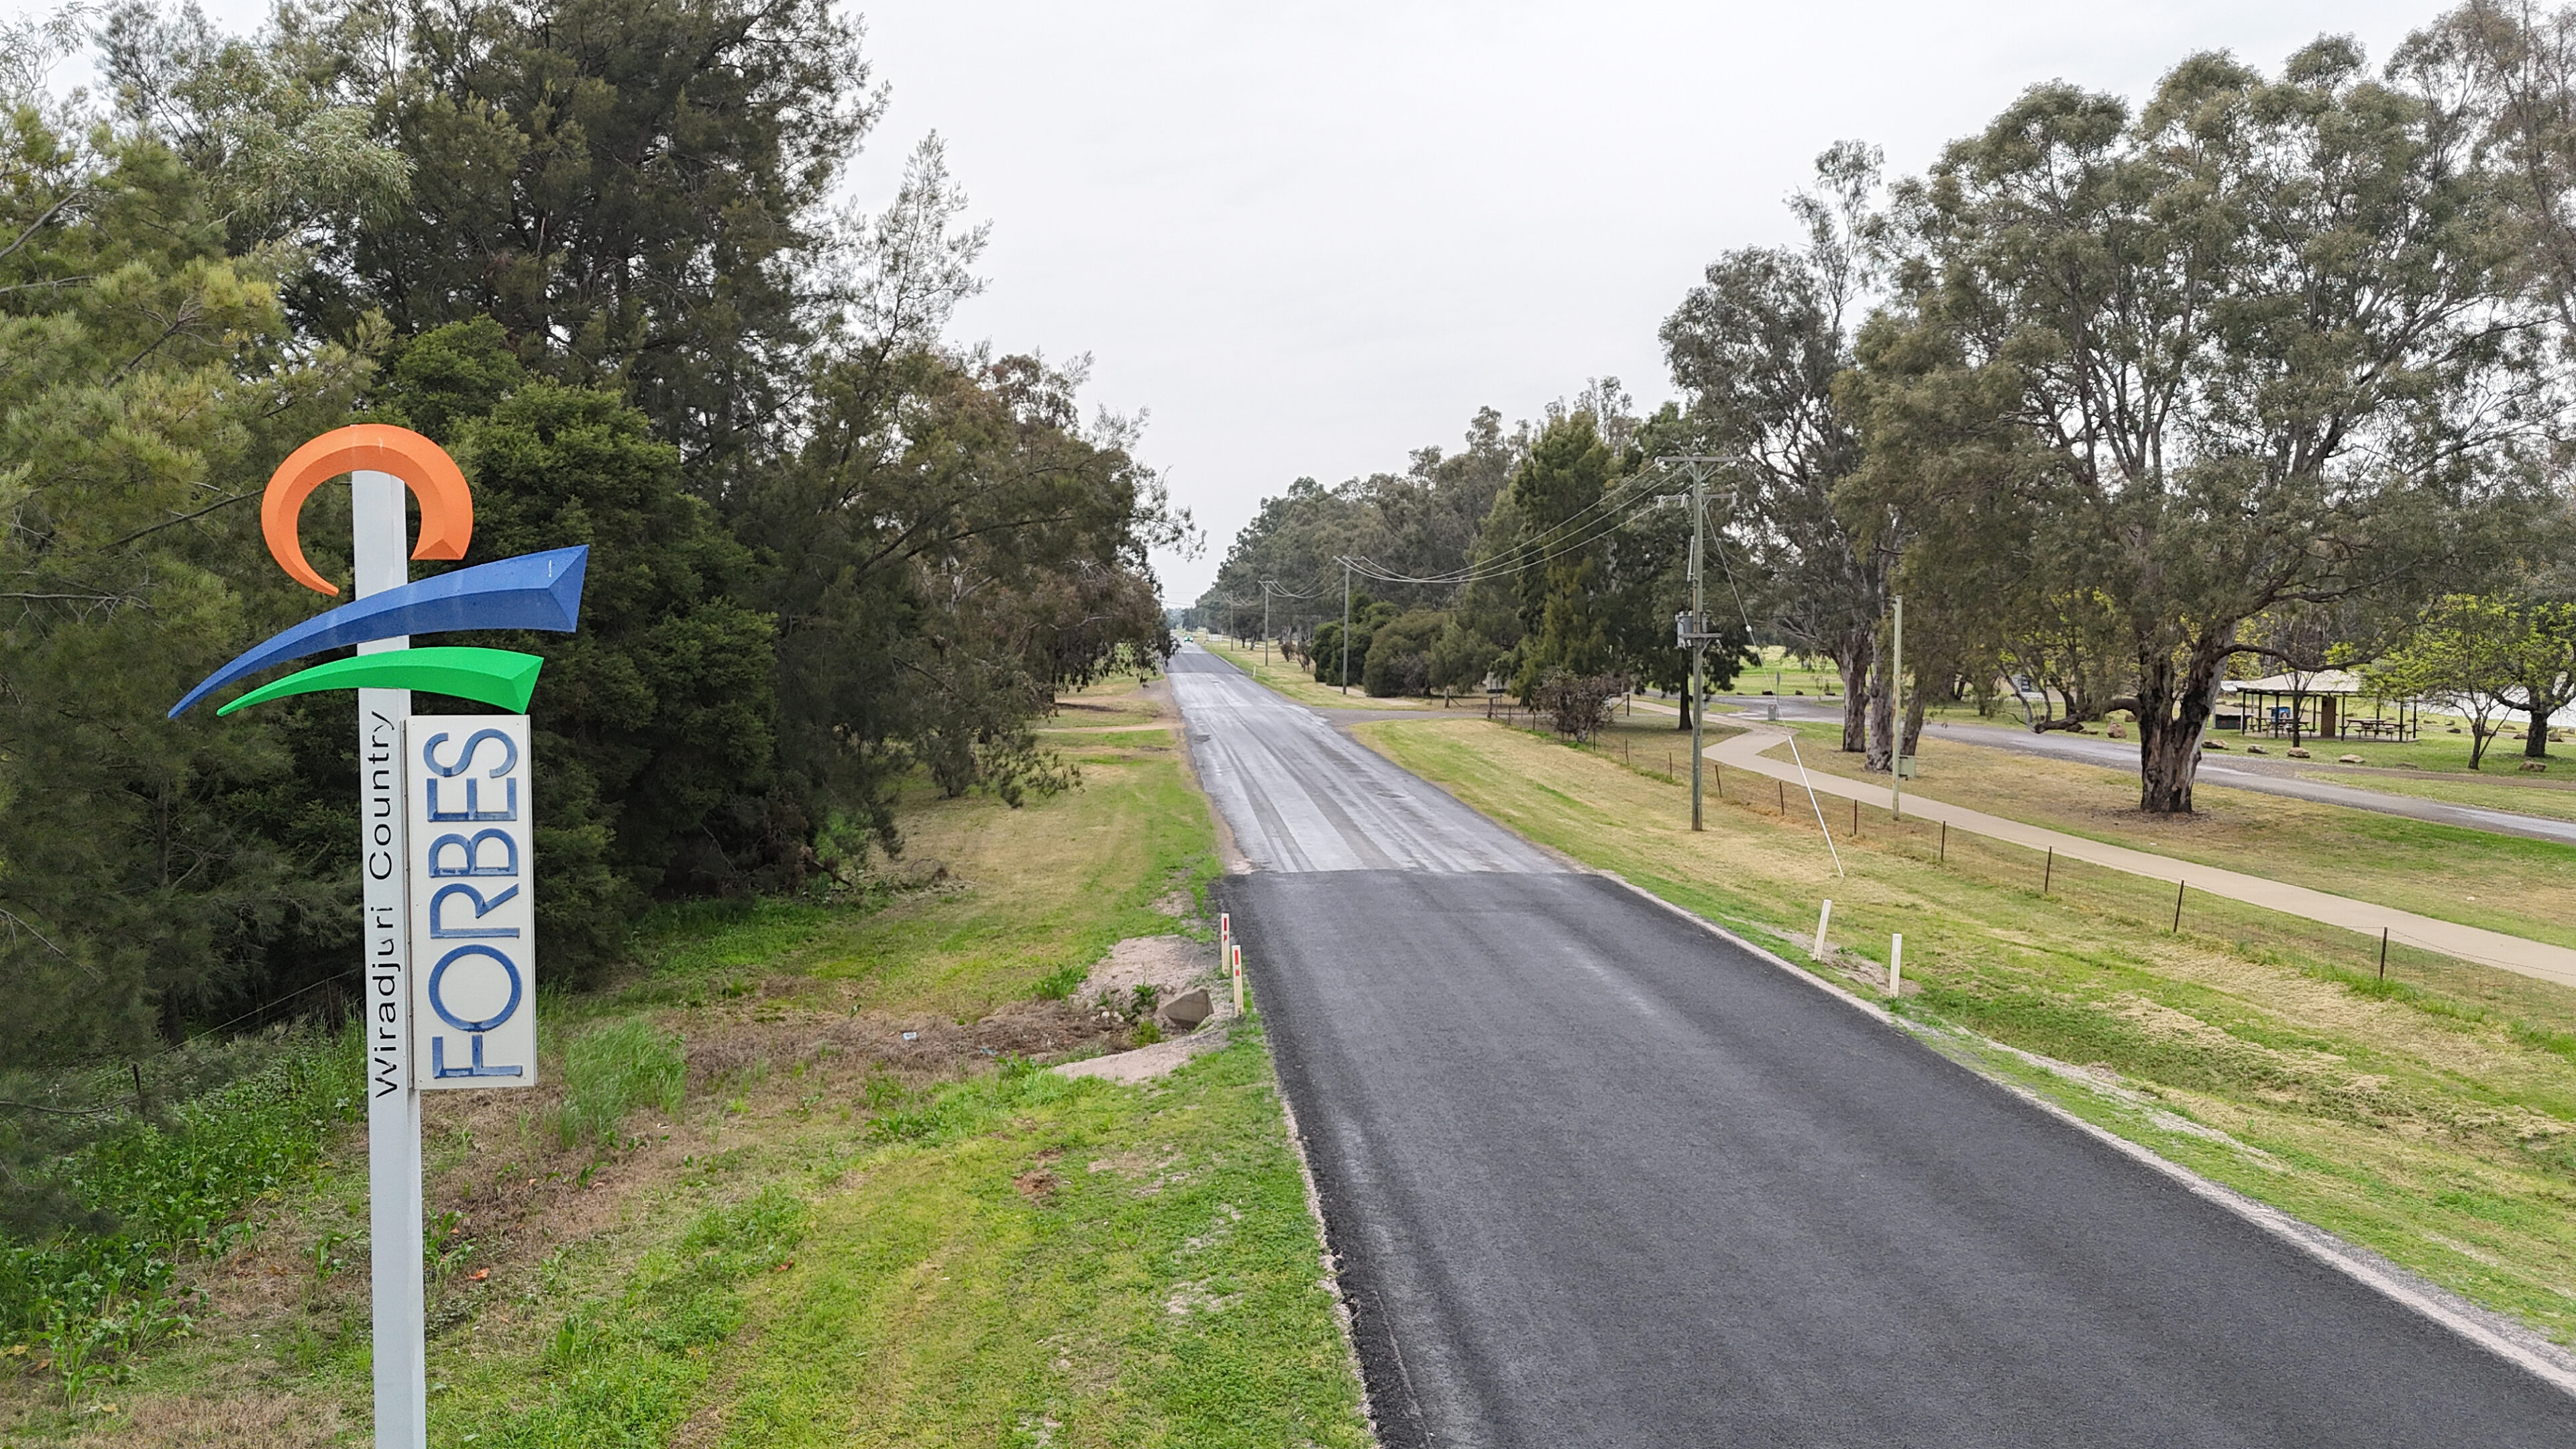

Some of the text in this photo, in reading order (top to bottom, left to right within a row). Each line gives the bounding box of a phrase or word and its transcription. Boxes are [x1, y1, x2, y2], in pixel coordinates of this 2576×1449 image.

[368, 710, 400, 1098] Wiradjuri Country
[423, 728, 523, 1079] FORBES
